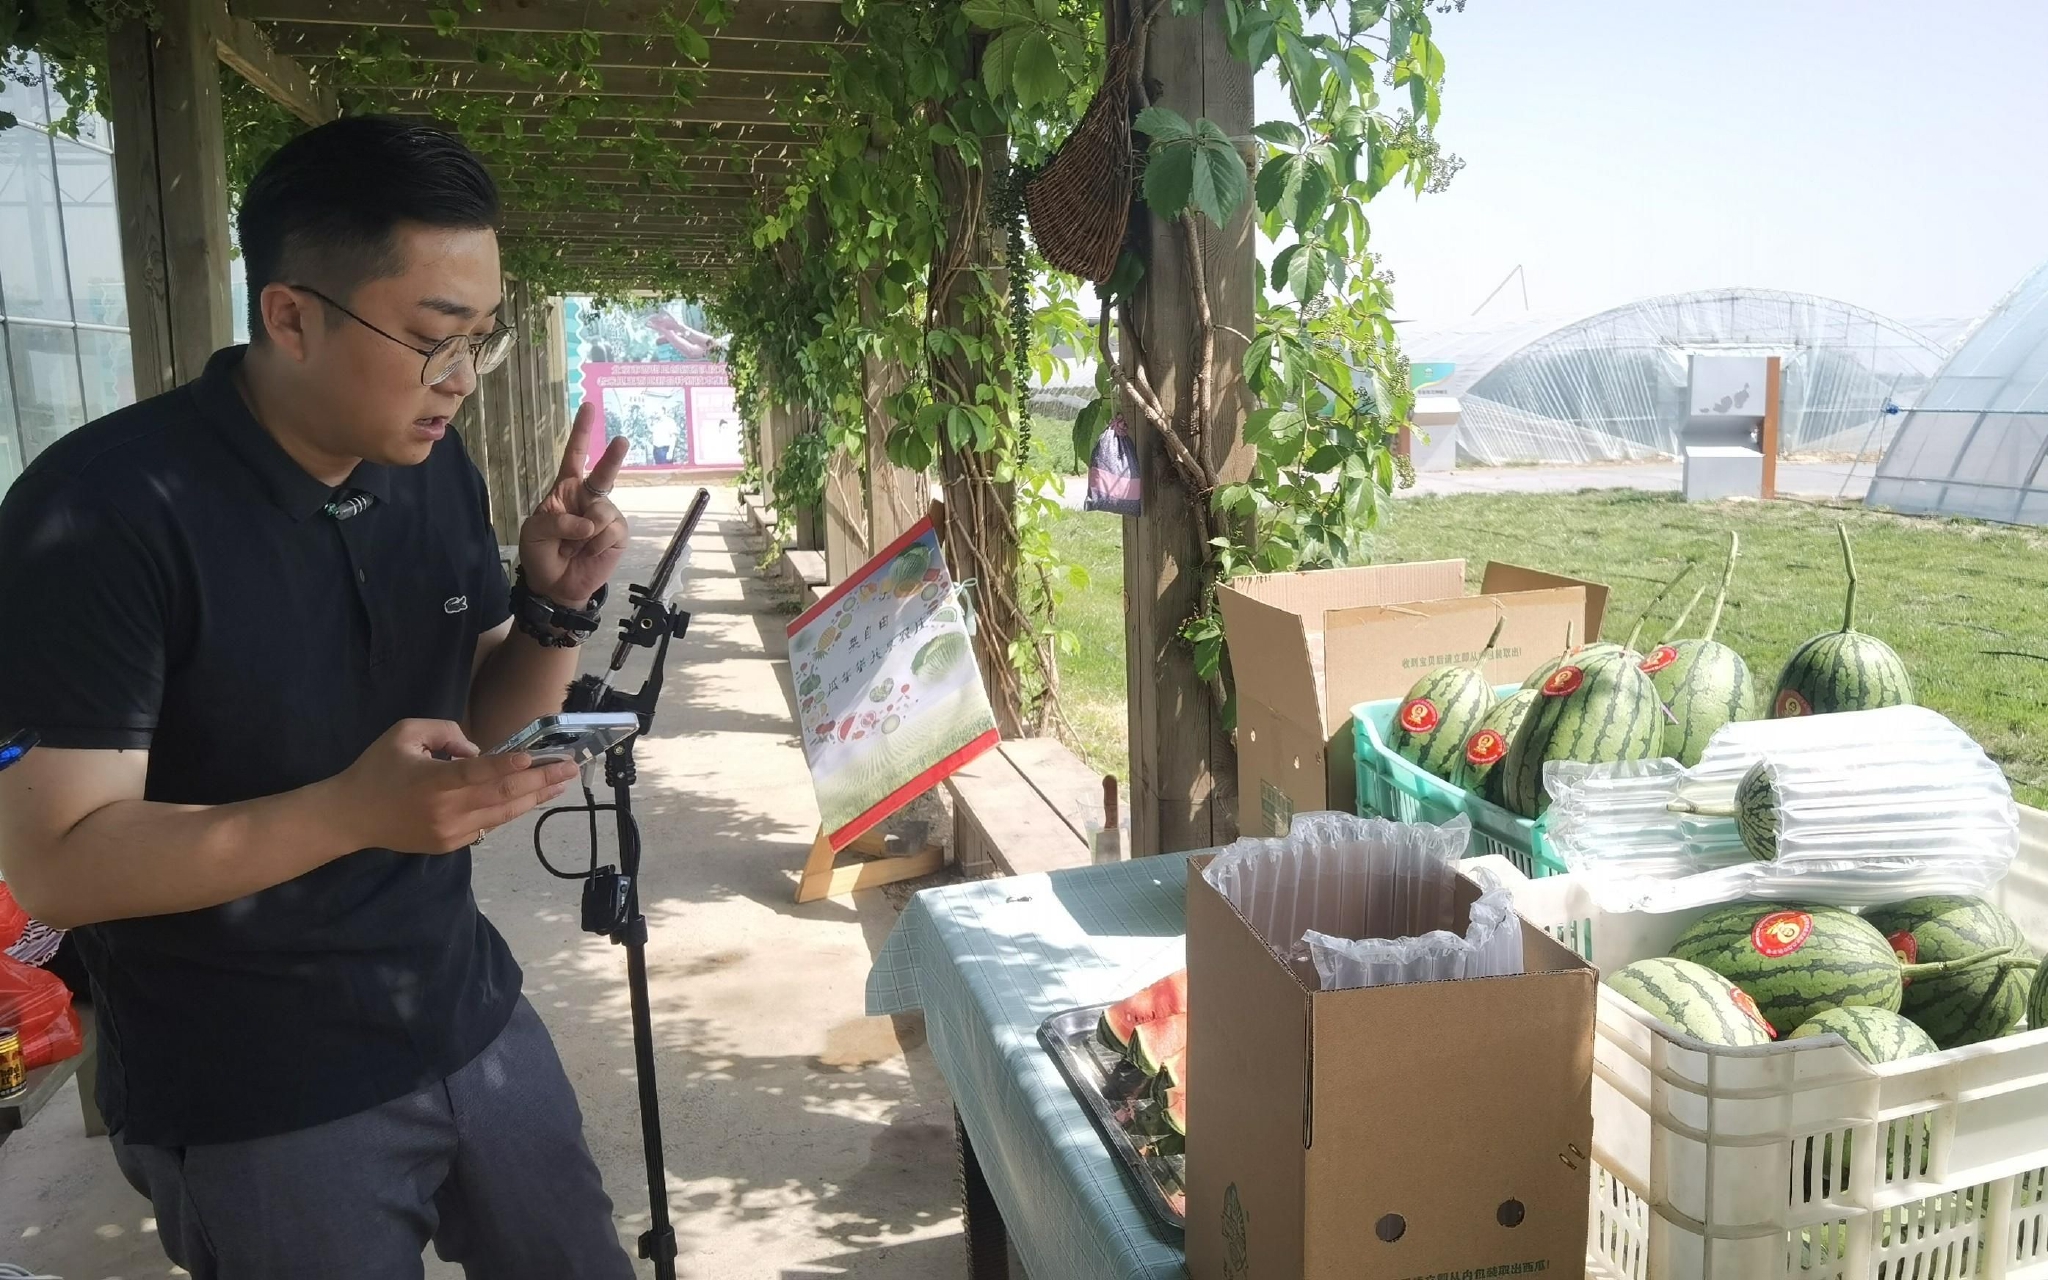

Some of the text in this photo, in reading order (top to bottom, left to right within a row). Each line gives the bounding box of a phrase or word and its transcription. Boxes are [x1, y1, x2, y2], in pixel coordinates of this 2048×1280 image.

[1401, 646, 1522, 669] 收到宝贝后请立即从包装取出!
